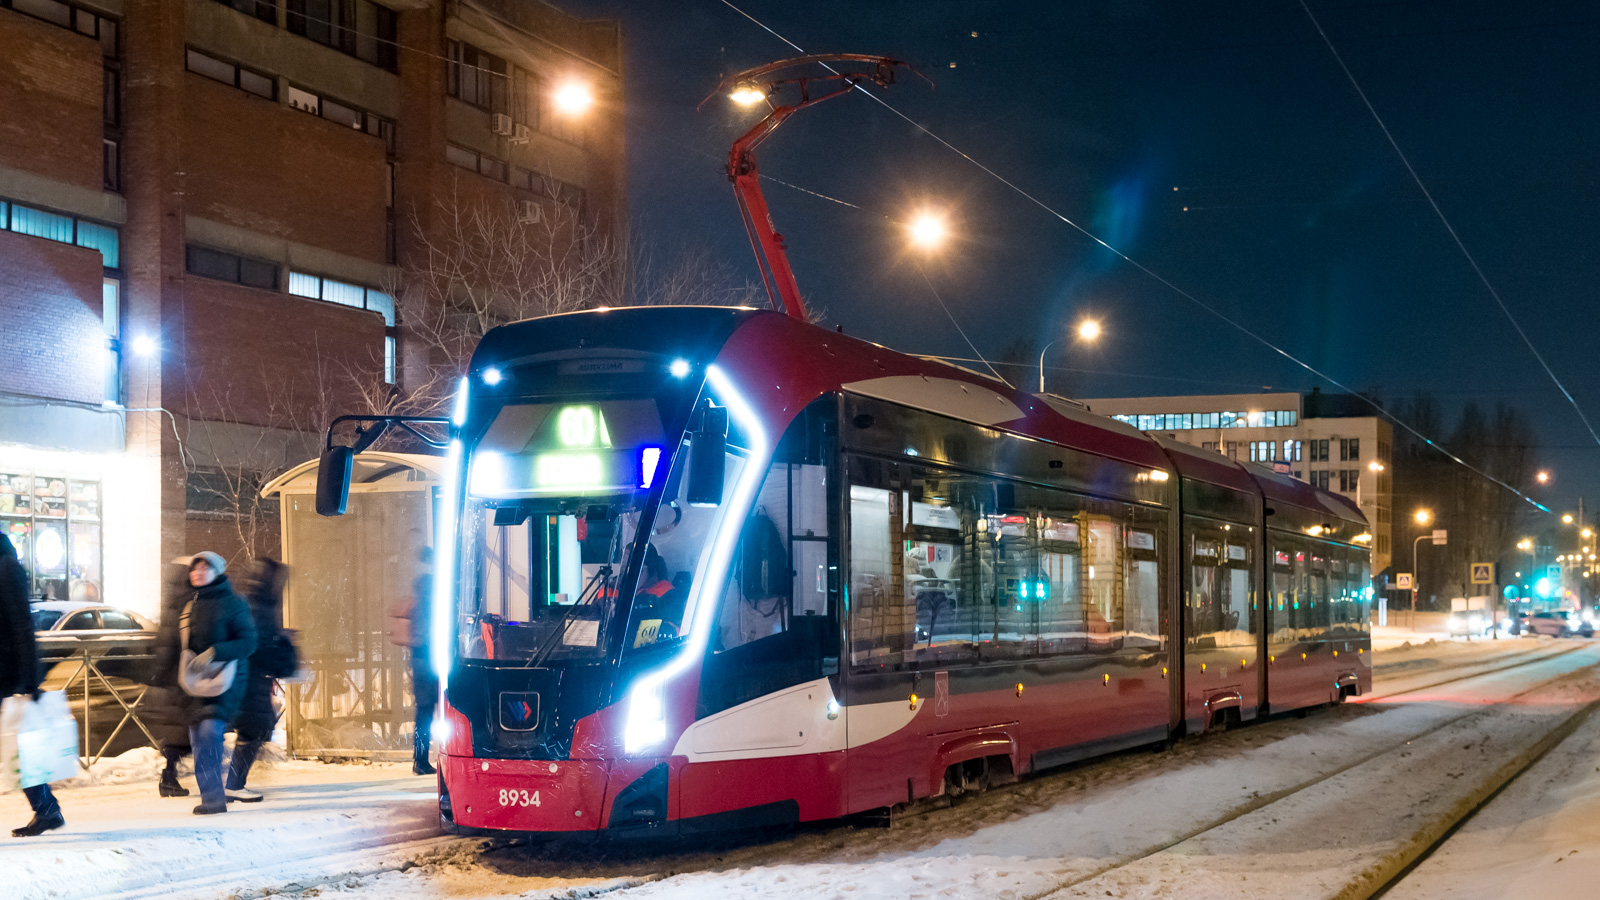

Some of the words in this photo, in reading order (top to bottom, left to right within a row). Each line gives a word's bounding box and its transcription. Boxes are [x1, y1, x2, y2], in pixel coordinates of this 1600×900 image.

[560, 407, 595, 446] 60
[641, 625, 657, 639] 60
[498, 788, 541, 808] 8934
